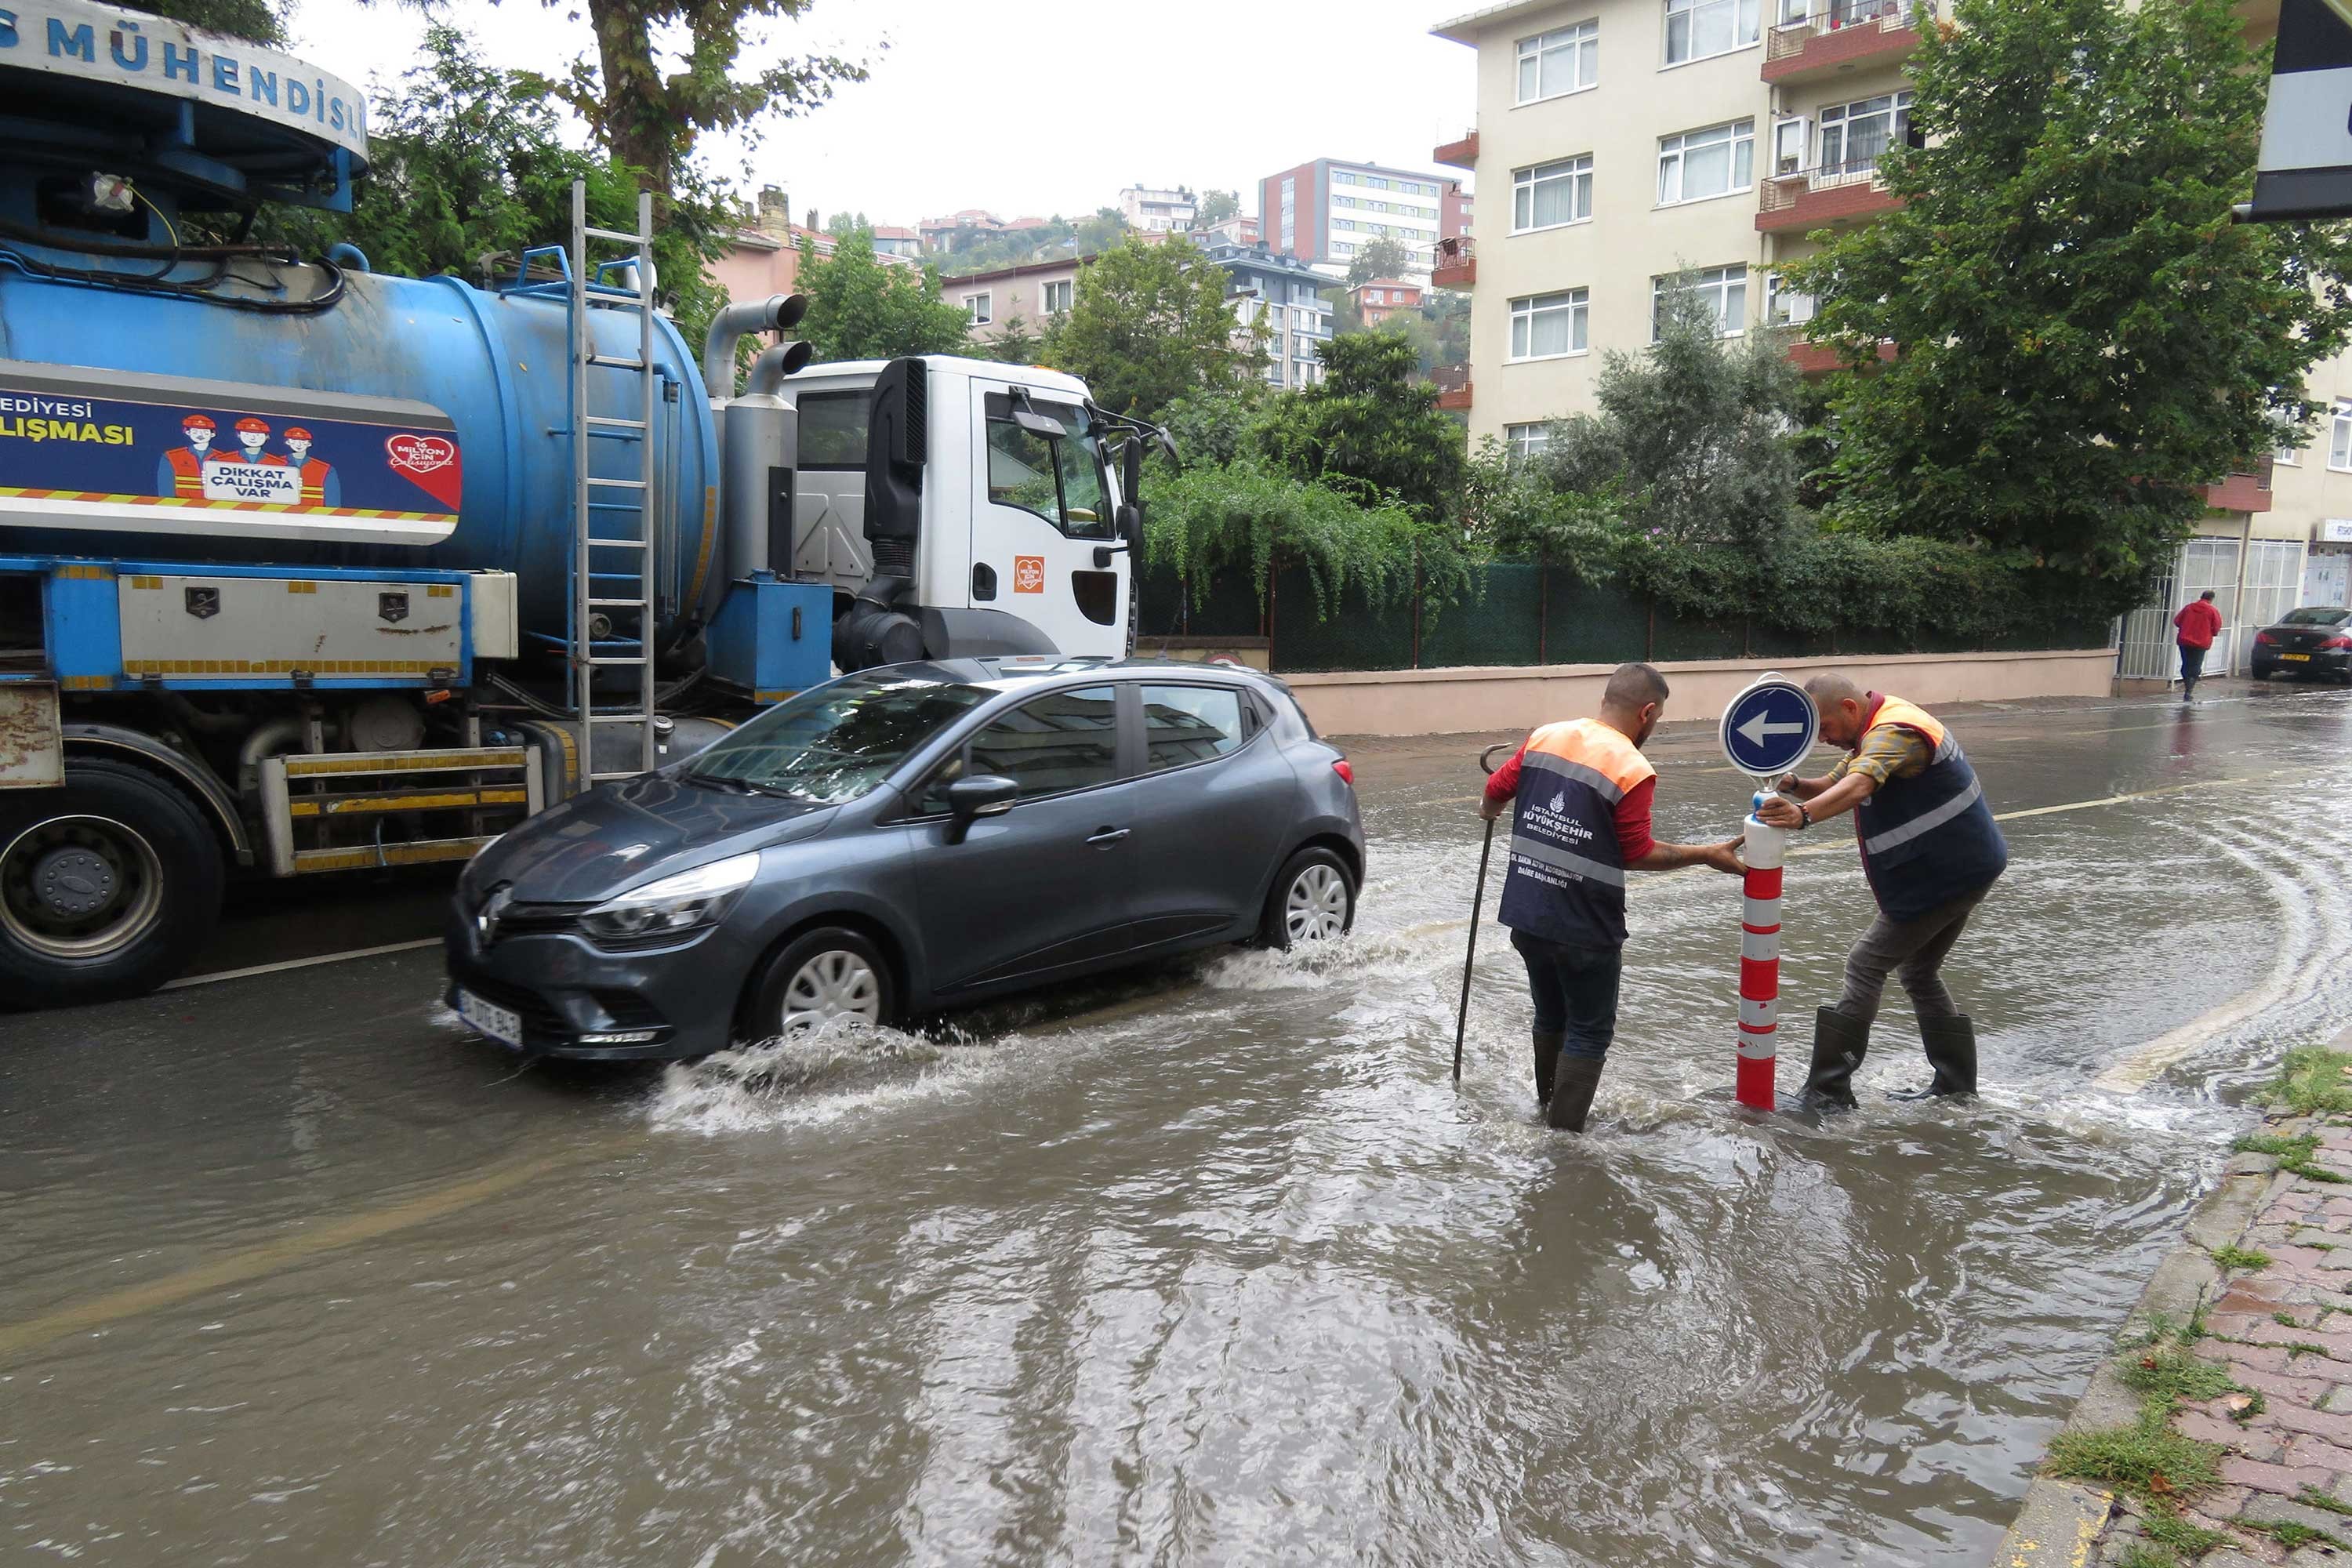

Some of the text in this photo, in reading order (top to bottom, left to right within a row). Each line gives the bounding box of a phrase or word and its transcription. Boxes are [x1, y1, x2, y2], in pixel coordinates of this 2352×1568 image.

[220, 466, 285, 479] DİKKAT
[211, 476, 294, 490] ÇALIŞMA
[235, 488, 271, 498] VAR
[1531, 804, 1582, 827] İSTANBUL
[1526, 823, 1578, 845] BELEDİYESİ
